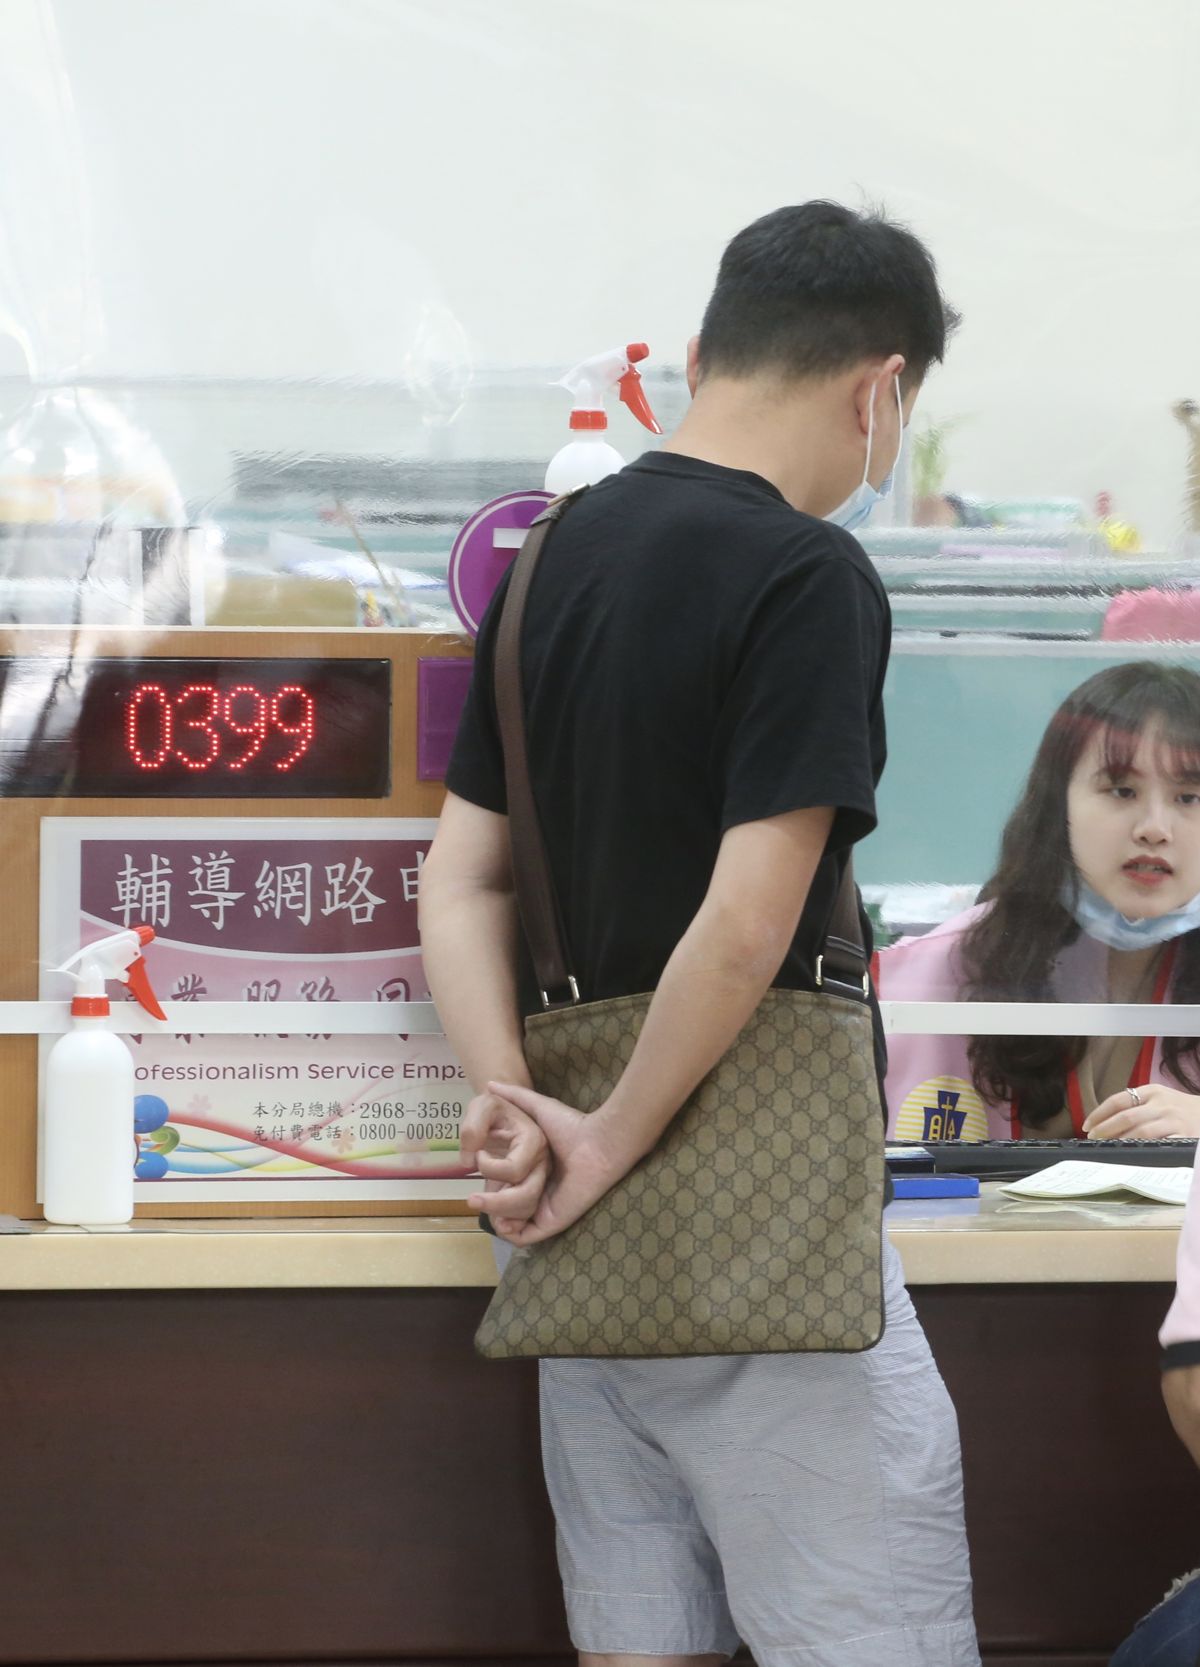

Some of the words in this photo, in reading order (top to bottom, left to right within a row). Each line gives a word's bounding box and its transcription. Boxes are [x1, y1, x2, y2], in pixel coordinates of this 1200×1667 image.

[126, 685, 315, 770] 0399
[134, 1062, 299, 1081] ofessionalism
[307, 1062, 395, 1081] Service
